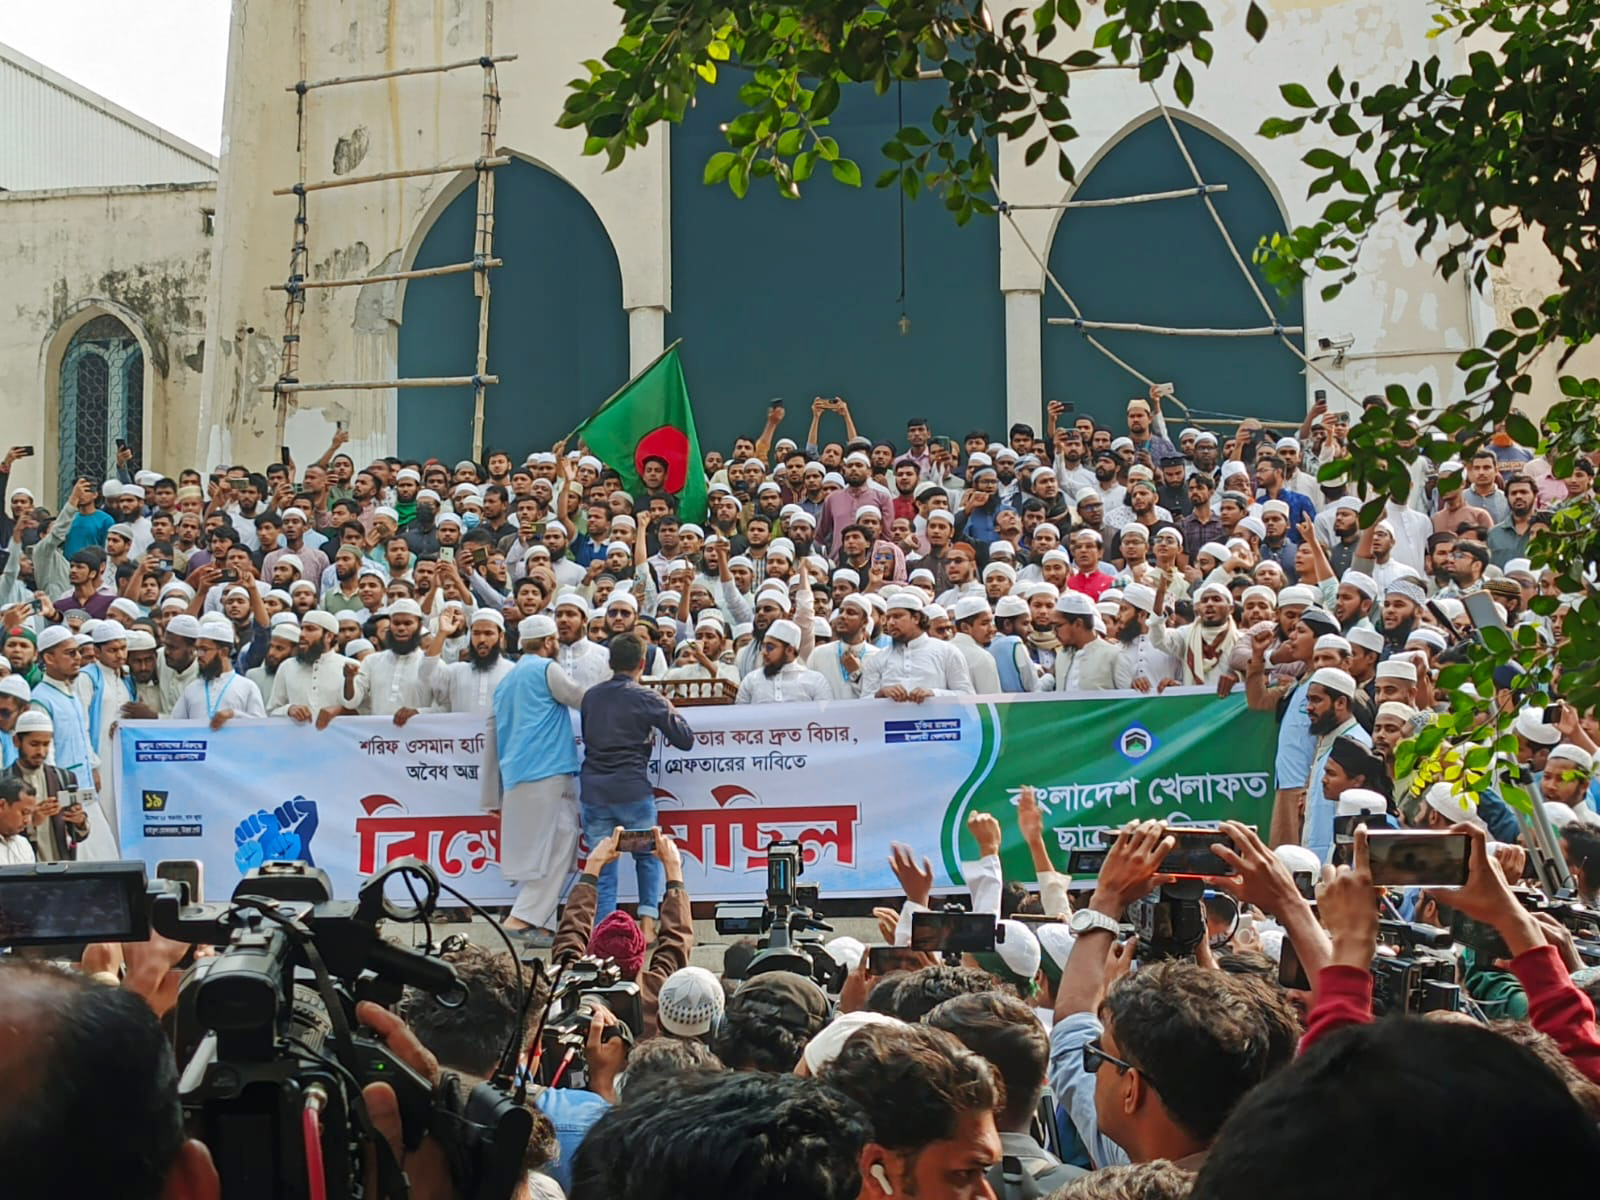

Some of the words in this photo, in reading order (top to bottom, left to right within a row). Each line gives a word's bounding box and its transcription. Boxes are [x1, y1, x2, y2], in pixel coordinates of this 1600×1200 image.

[360, 735, 399, 755] শরিফ
[405, 738, 454, 754] ওসমান
[731, 729, 764, 745] করে
[769, 728, 802, 746] দ্রুত
[406, 762, 448, 780] অবৈধ
[665, 756, 745, 774] গ্রেফতারের
[752, 750, 807, 772] দাবিতে
[1006, 776, 1140, 815] বংলাদেশ
[1148, 772, 1269, 804] খেলাফত
